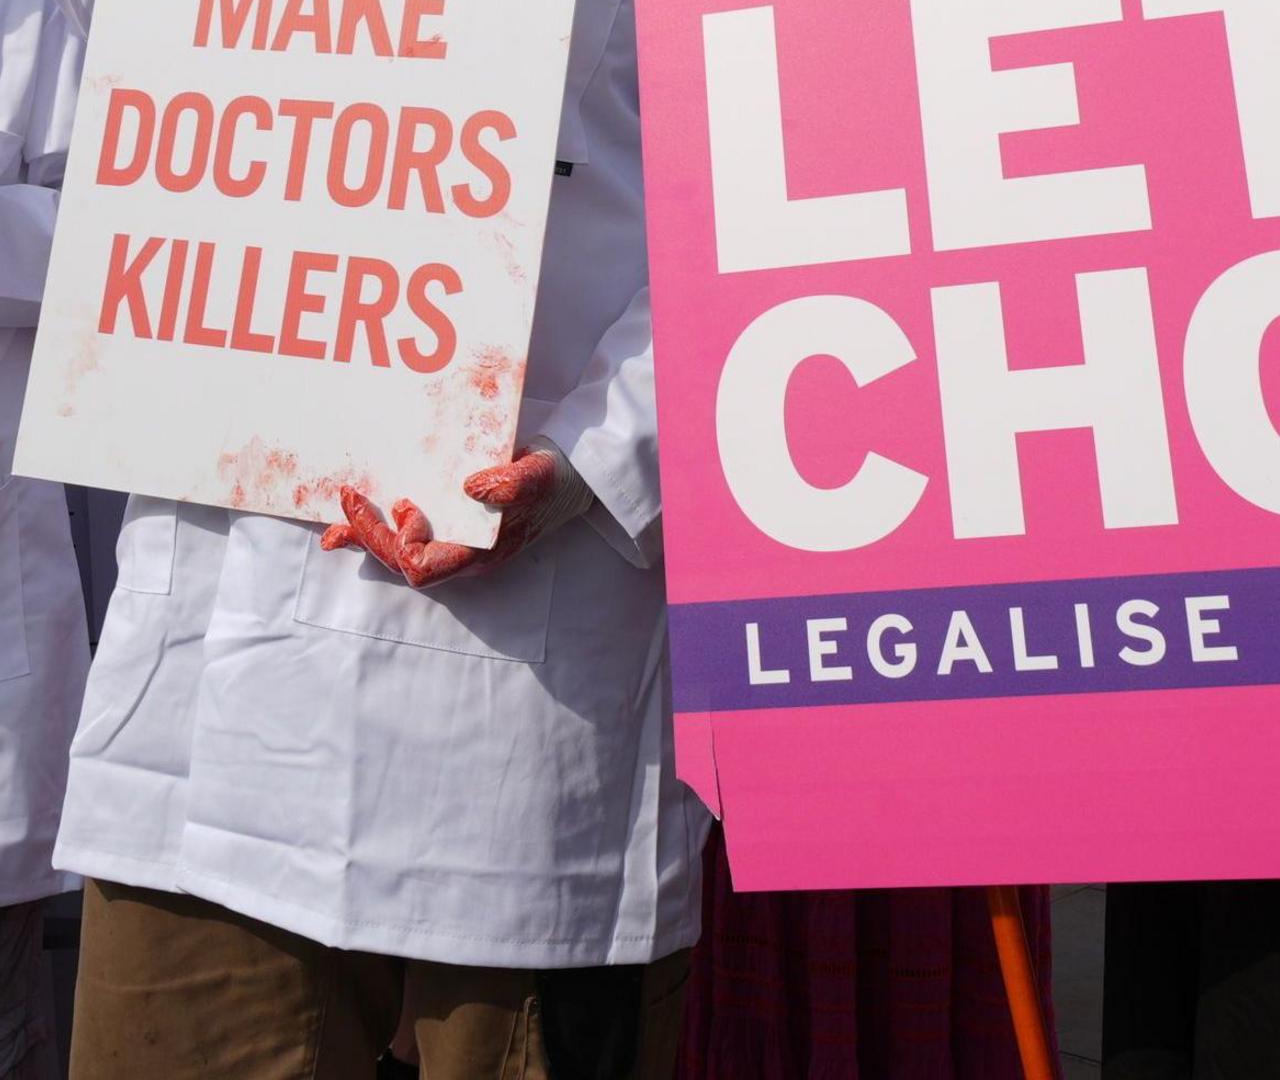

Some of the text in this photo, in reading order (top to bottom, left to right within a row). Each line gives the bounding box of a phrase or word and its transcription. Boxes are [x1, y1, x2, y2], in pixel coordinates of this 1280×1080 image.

[95, 88, 518, 218] DOCTORS
[97, 232, 463, 373] KILLERS
[744, 594, 1239, 686] LEGALISE
